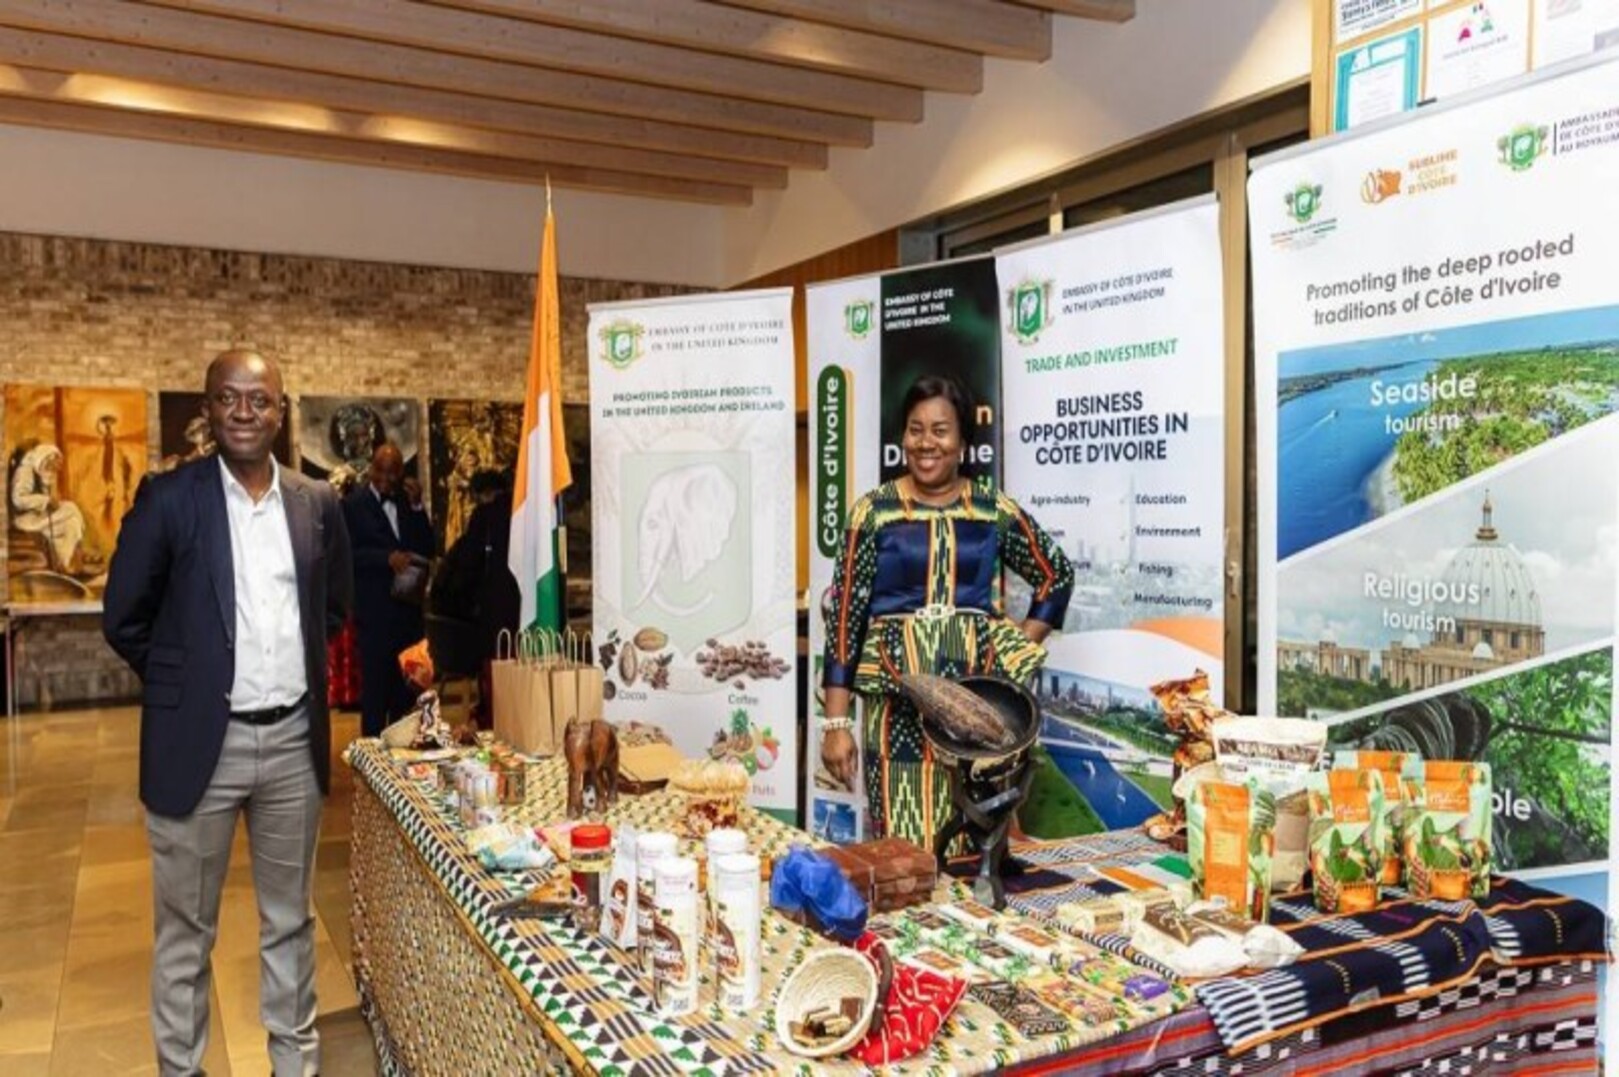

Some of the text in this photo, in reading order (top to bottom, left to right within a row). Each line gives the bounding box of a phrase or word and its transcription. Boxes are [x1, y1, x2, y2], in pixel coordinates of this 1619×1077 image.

[1306, 233, 1575, 302] Promoting the deep rooted
[1062, 284, 1098, 299] EMBASSY
[1100, 280, 1110, 292] OF
[1062, 287, 1166, 314] IN THE UNITED KINGDOM
[1314, 271, 1562, 325] traditions of Côte d'Ivoire
[666, 340, 683, 351] THE
[687, 338, 726, 349] UNITED
[728, 335, 778, 347] KINGDOM
[1025, 338, 1178, 374] TRADE AND INVESTMENT
[613, 391, 669, 404] PROMOTING
[720, 386, 773, 398] PRODUCTS
[1370, 373, 1477, 406] Seaside
[602, 400, 786, 418] IN THE UNITED KINGDOM AND IRELAND
[1057, 390, 1143, 418] BUSINESS
[1020, 414, 1159, 444] OPPORTUNITIES
[1165, 412, 1188, 434] IN
[1384, 409, 1460, 435] tourism
[822, 376, 838, 547] Côte d'Ivoire
[1035, 439, 1167, 466] CÔTE D'IVOIRE
[1030, 493, 1091, 508] Agro-industry
[1135, 493, 1187, 505] Education
[1135, 525, 1201, 537] Environment
[1139, 561, 1173, 578] Fishing
[1134, 591, 1213, 611] Manufacturing
[1364, 572, 1480, 607] Religious
[1383, 607, 1456, 633] tourism
[618, 690, 647, 702] Cocoa
